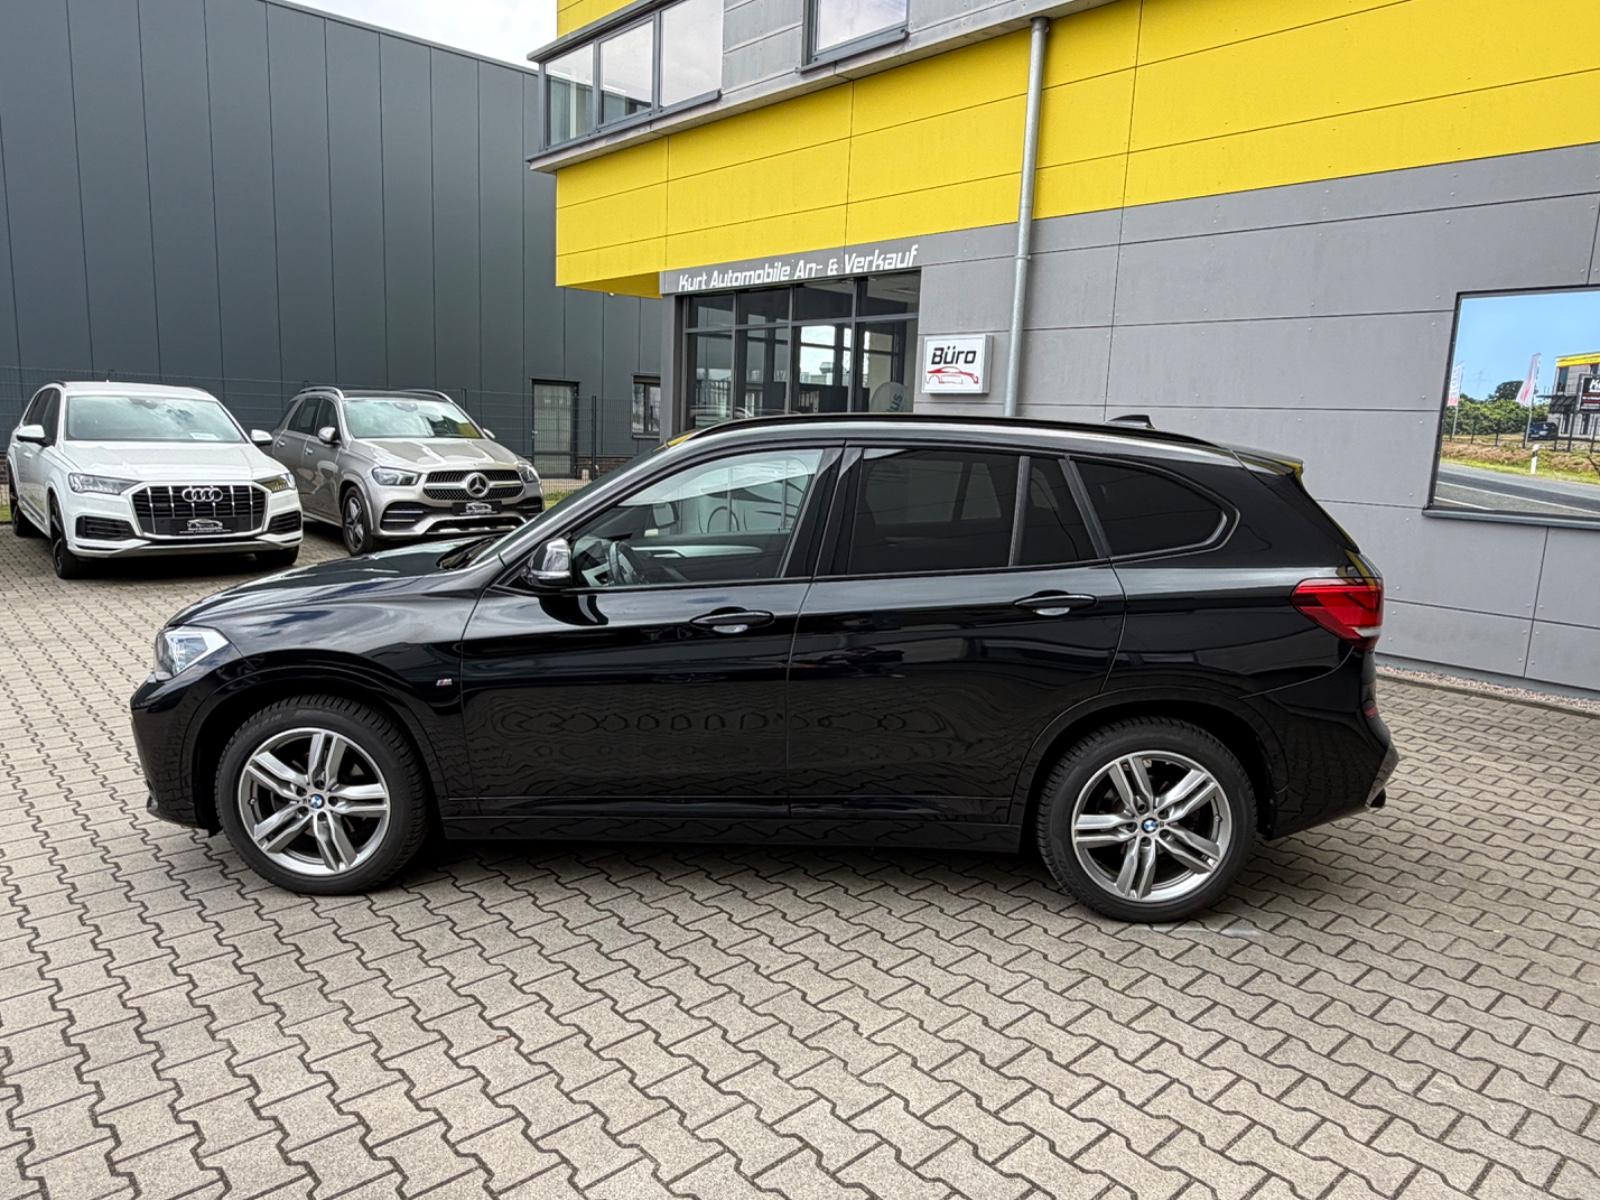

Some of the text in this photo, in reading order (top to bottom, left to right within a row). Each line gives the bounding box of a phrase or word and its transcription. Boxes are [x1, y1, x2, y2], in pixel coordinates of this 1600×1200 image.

[678, 244, 918, 292] Kurt Automobile An- & Verkauf
[931, 345, 976, 365] Büro
